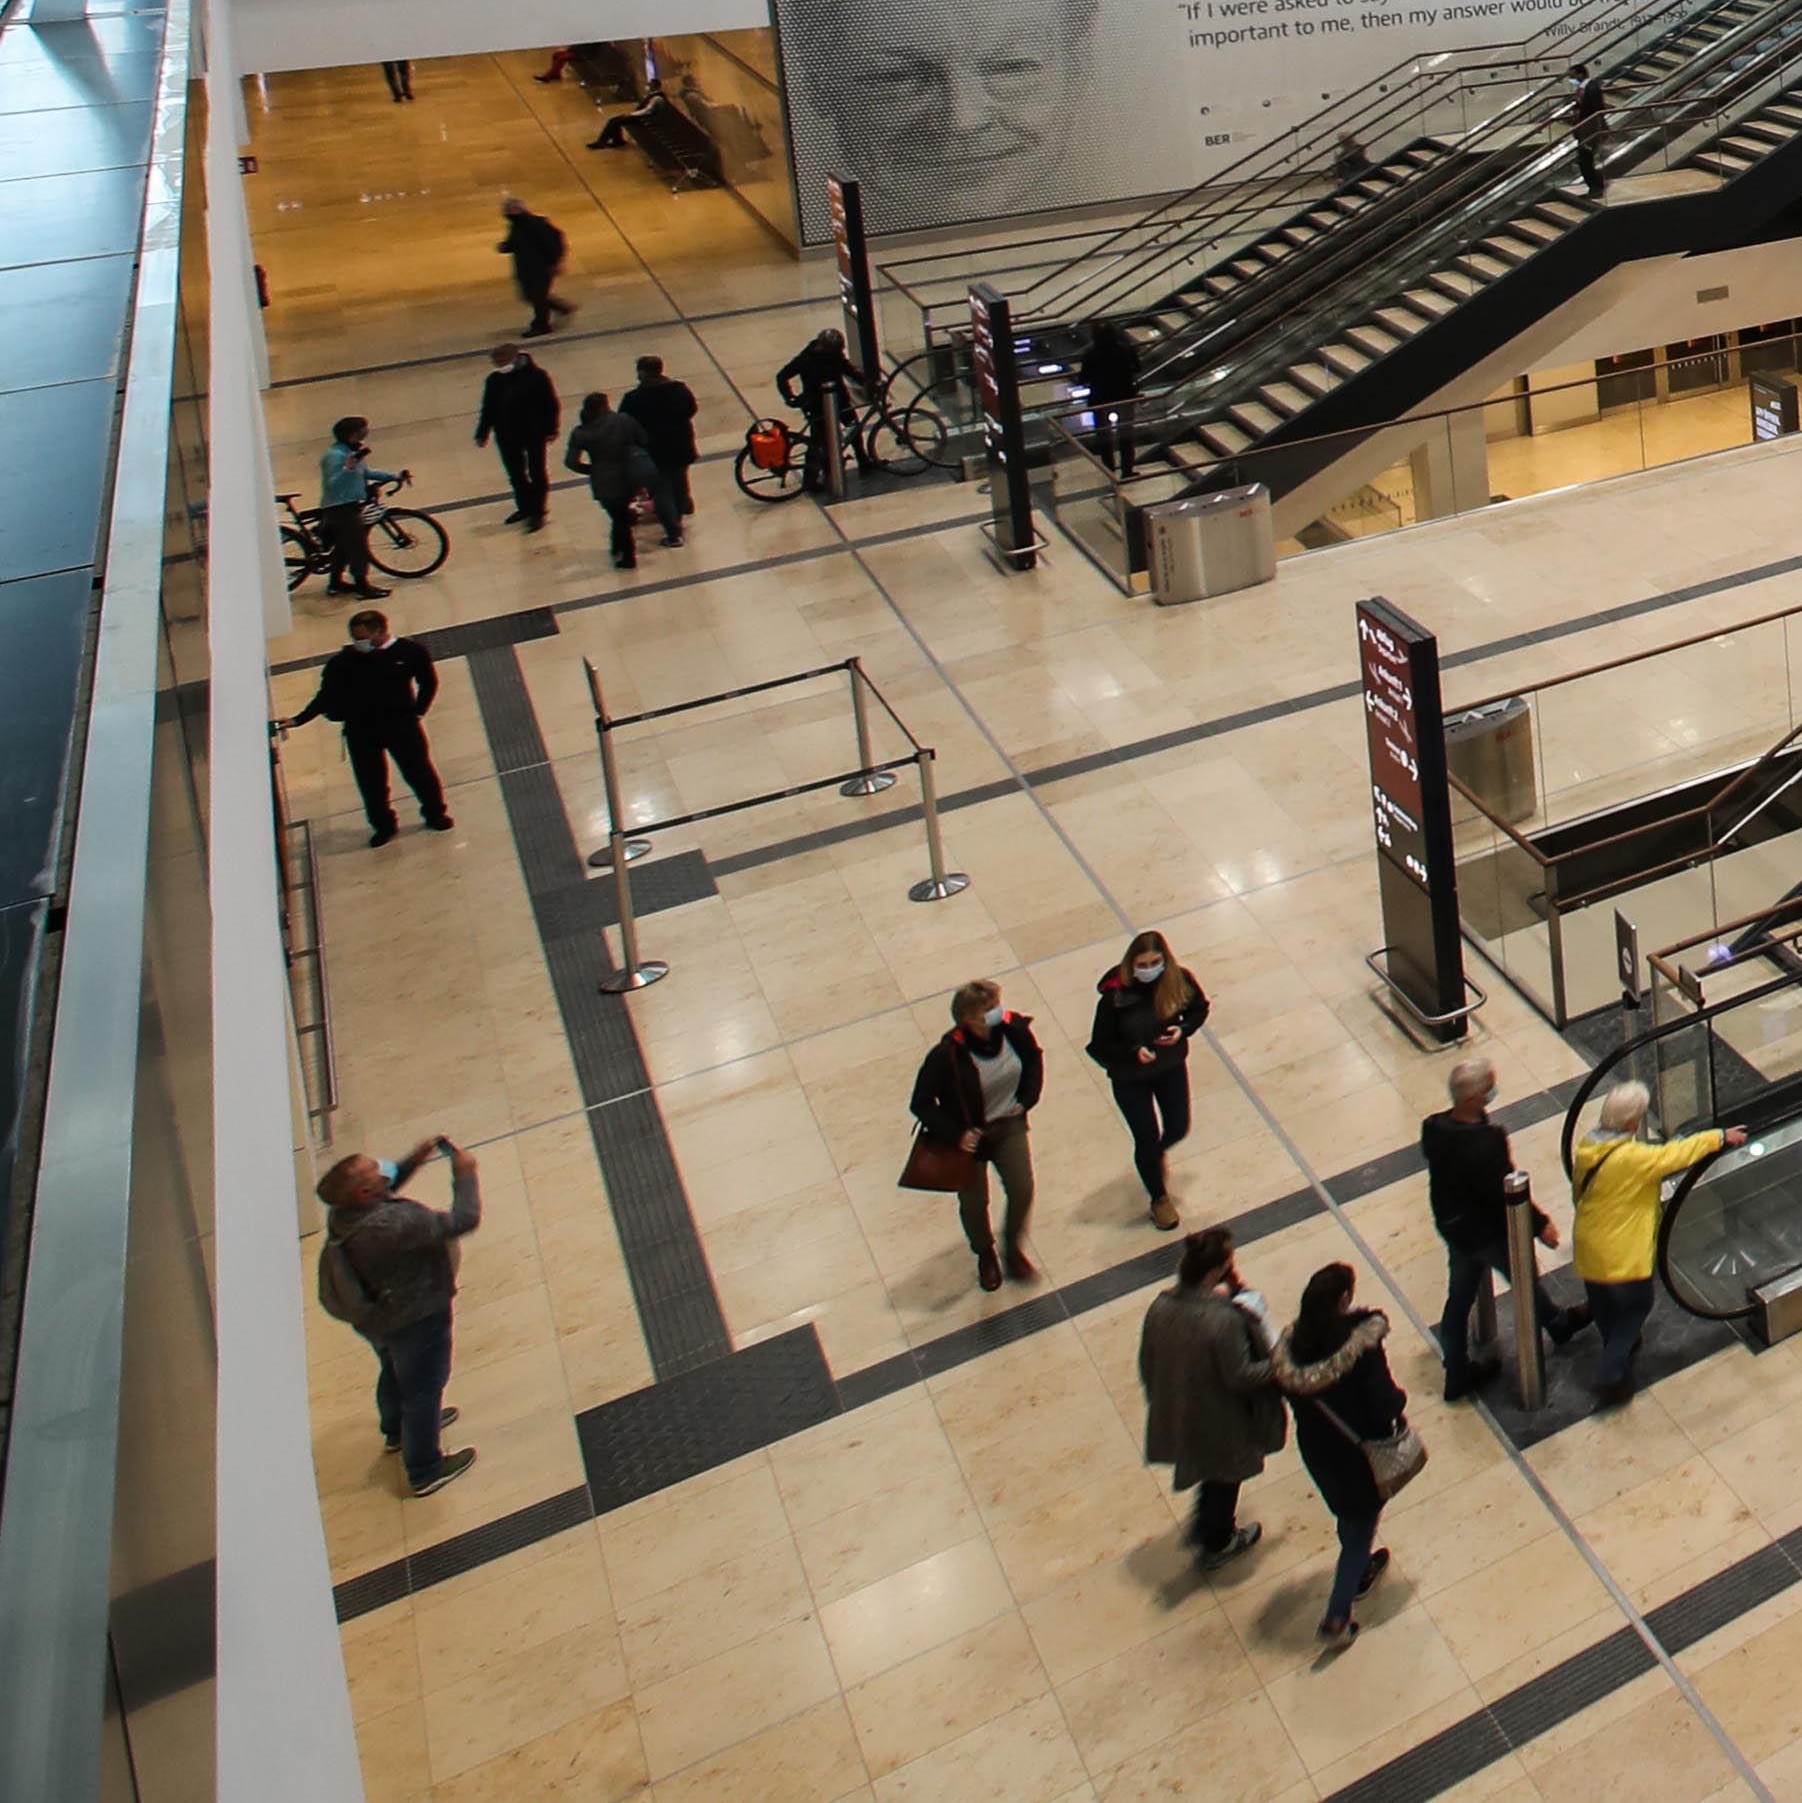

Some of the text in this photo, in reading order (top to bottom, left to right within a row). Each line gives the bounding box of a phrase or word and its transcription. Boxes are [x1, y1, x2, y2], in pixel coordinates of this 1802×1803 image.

[1206, 2, 1213, 19] I
[1189, 19, 1289, 49] important
[1295, 20, 1315, 36] to
[1321, 16, 1355, 34] me,
[1361, 9, 1402, 30] then
[1409, 6, 1438, 27] my
[1443, 0, 1505, 21] answer
[1205, 133, 1231, 147] BER
